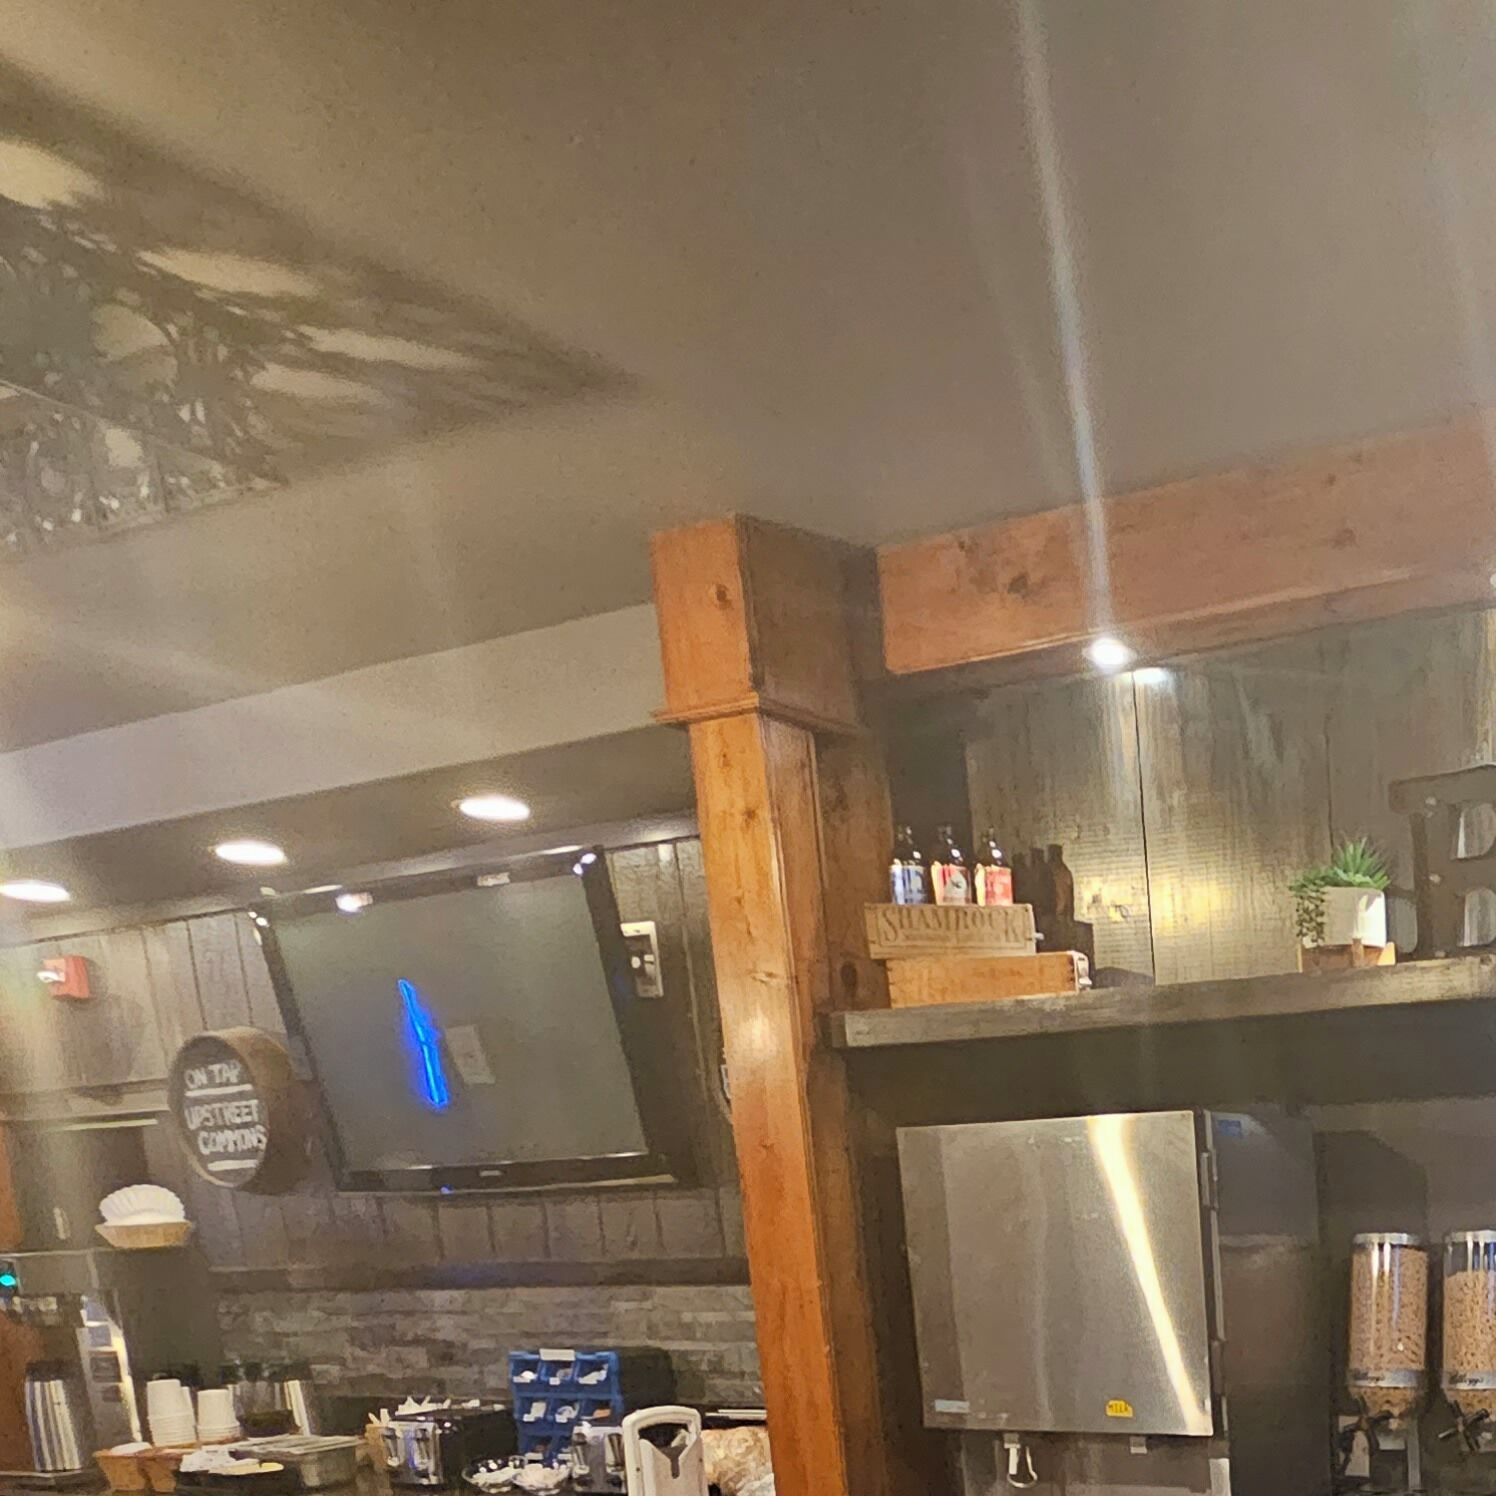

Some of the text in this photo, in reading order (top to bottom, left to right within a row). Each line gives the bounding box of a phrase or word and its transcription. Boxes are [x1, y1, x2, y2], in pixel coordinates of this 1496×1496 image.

[881, 906, 1018, 942] SHAMROCK
[185, 1060, 241, 1089] ON TAP
[185, 1099, 259, 1130] UPSTREET
[198, 1125, 267, 1155] COMMONS
